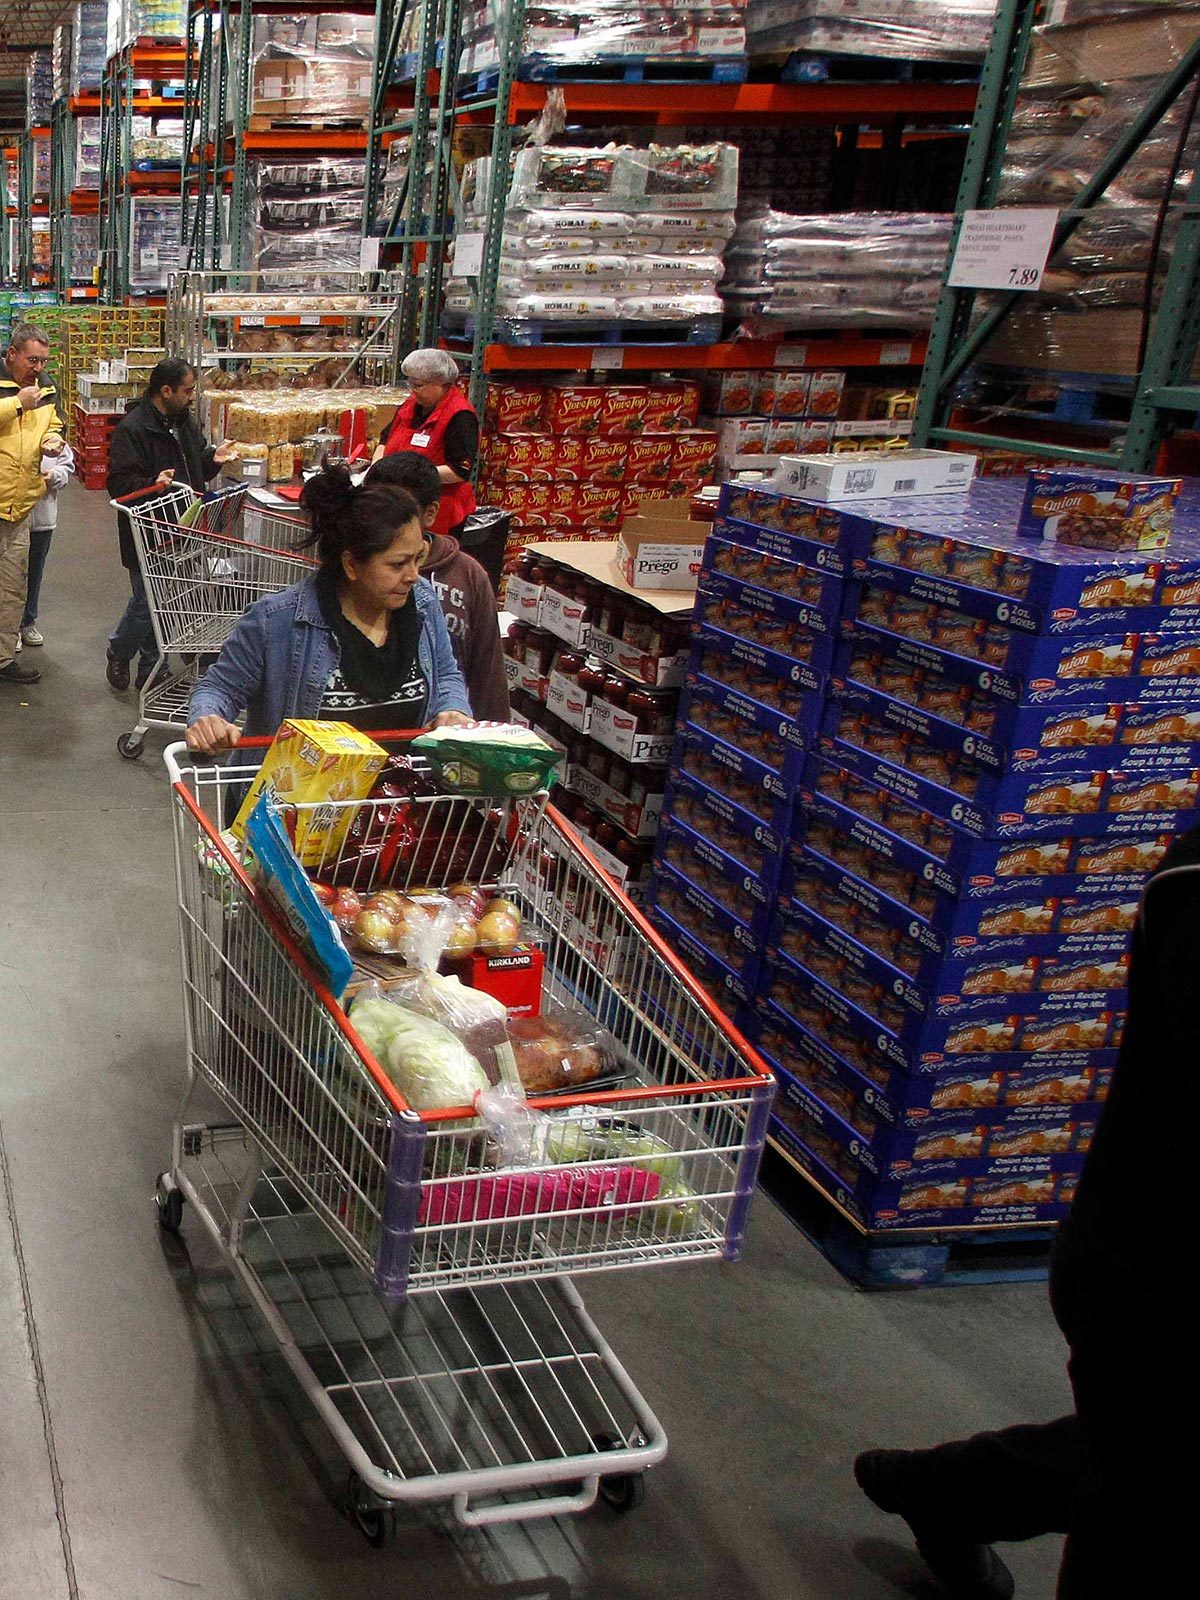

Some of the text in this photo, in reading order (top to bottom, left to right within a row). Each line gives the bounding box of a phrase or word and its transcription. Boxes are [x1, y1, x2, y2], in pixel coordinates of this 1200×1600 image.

[555, 219, 585, 228] HOMAI
[662, 219, 692, 227] HOMAI
[552, 263, 581, 271] HOMAI
[1008, 269, 1038, 285] 7.89
[544, 302, 573, 310] HOMAI
[500, 395, 542, 413] Stove Top
[559, 396, 601, 416] Stove Top
[603, 396, 646, 416] Stove Top
[665, 395, 682, 408] Top
[585, 443, 612, 462] Stove
[610, 443, 627, 456] Top
[629, 442, 671, 462] Stove Top
[674, 442, 716, 462] Stove Top
[578, 489, 620, 507] Stove Top
[623, 488, 665, 507] Stove Top
[1120, 486, 1126, 494] 6
[1044, 497, 1081, 512] Onion
[817, 549, 826, 565] 6
[638, 559, 678, 574] Prego
[1080, 583, 1112, 604] nion
[997, 602, 1009, 621] 6
[1170, 608, 1200, 616] Onion
[1010, 615, 1036, 630] BOXES
[1050, 610, 1127, 632] Recipe Secrets
[1160, 619, 1185, 628] Soup
[1152, 651, 1190, 672] Onion
[505, 664, 518, 676] ego
[978, 671, 991, 690] 6
[992, 686, 1017, 700] BOXES
[593, 702, 610, 721] Prego
[1135, 720, 1172, 740] Onion
[963, 736, 976, 755] 6
[1130, 747, 1190, 756] Onion Recipe
[975, 751, 999, 767] BOXES
[1121, 759, 1145, 767] Soup
[1156, 757, 1171, 766] Dip
[1120, 789, 1156, 807] Onion
[1116, 813, 1144, 821] Onion
[1106, 824, 1131, 832] Soup
[923, 863, 934, 880] 6
[1085, 875, 1113, 883] Onion
[489, 957, 530, 967] KIRKLAND
